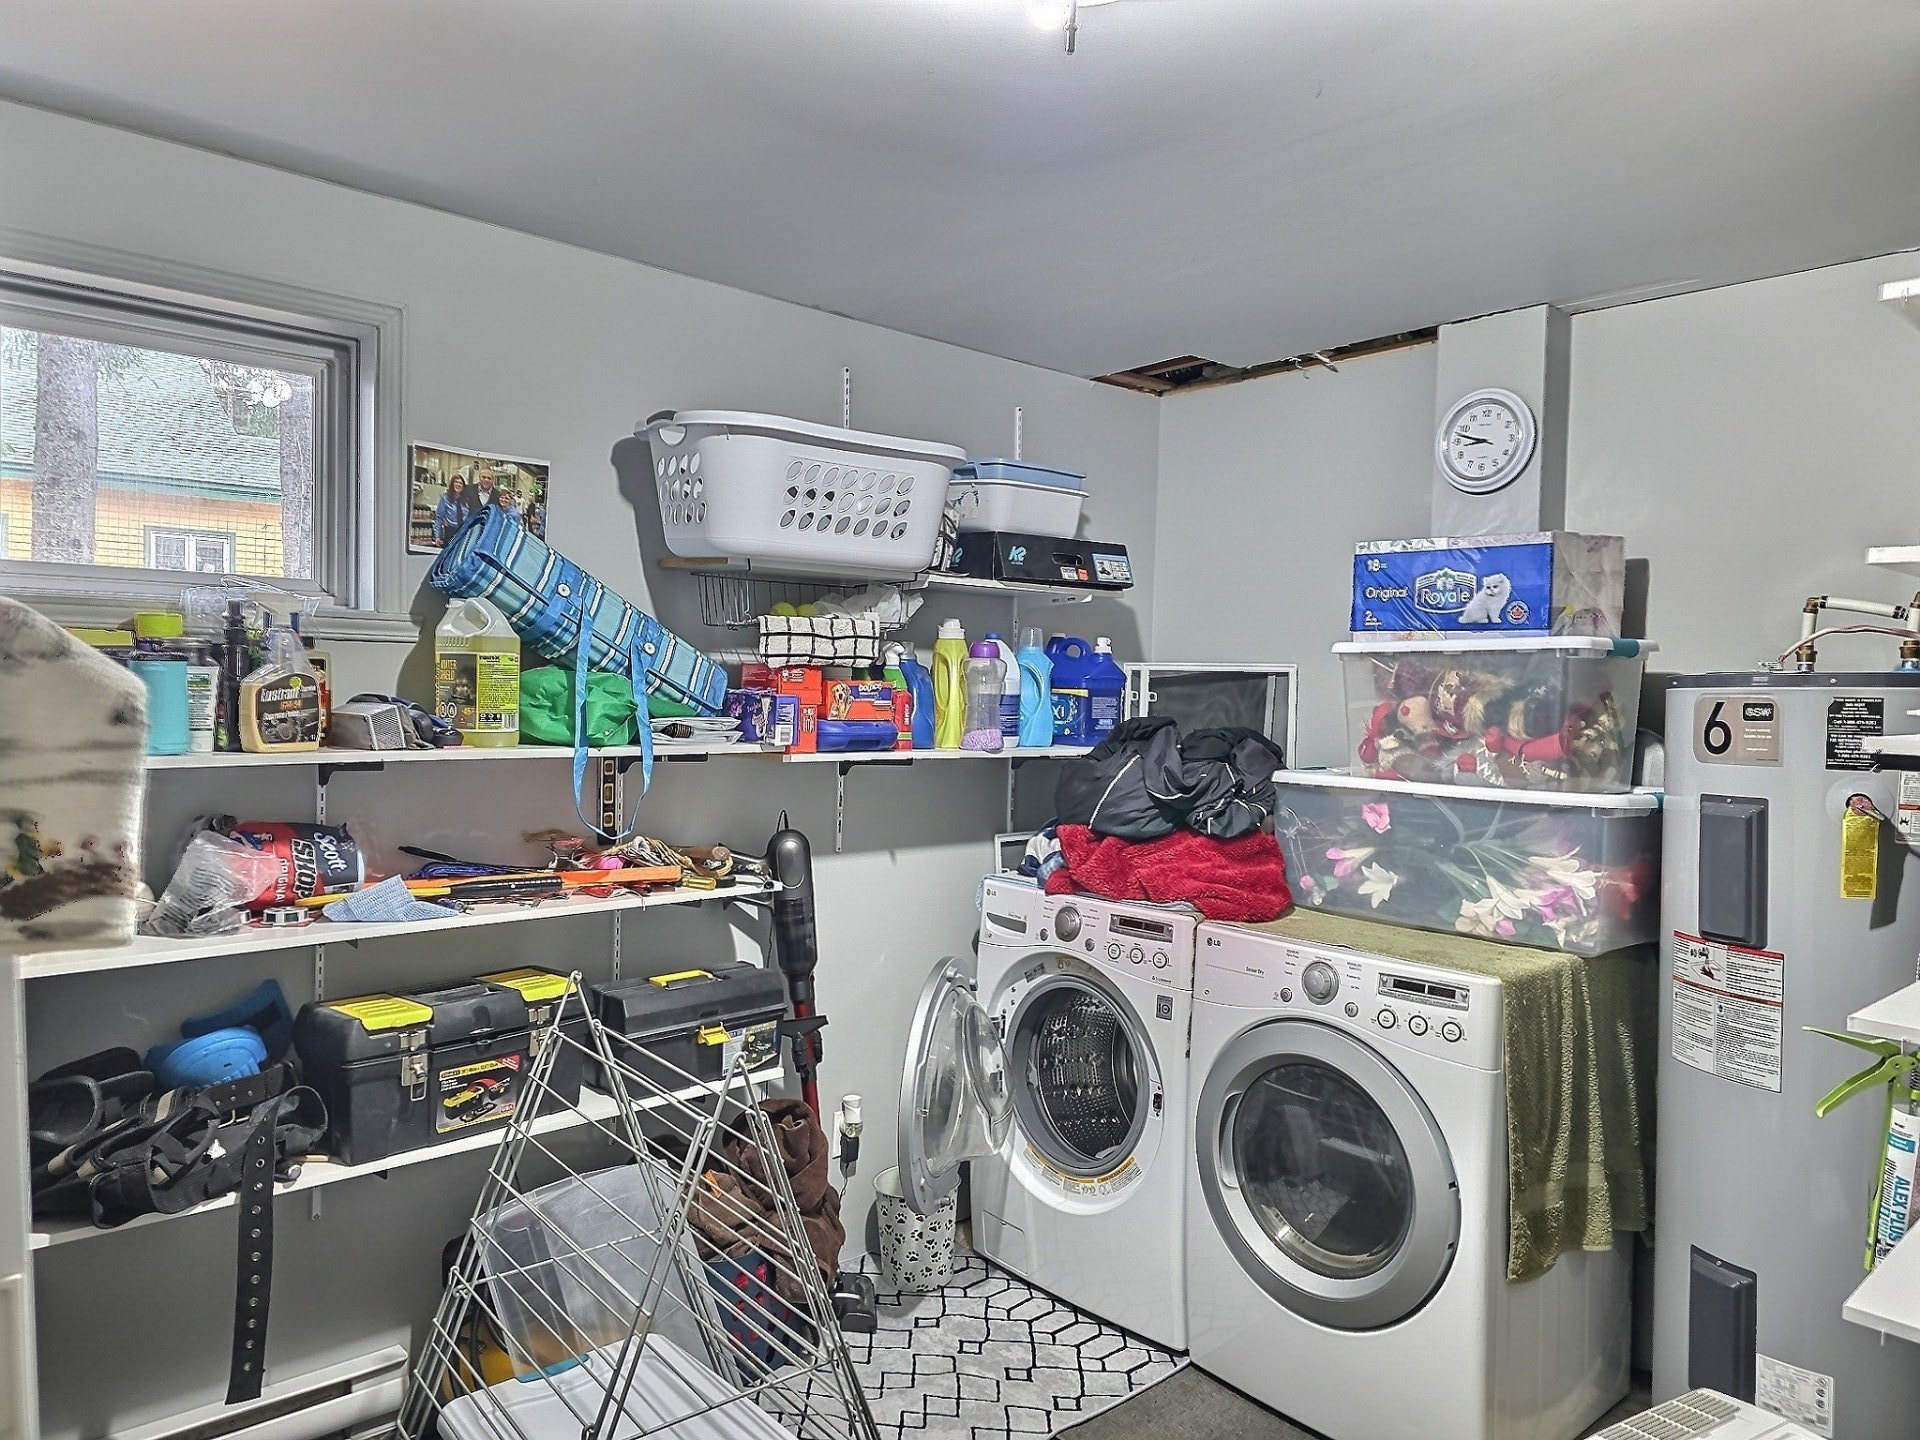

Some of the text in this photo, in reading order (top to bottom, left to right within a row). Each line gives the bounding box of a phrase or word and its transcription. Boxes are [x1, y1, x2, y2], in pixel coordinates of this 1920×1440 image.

[1008, 545, 1027, 562] K2
[1367, 558, 1381, 571] 18
[1365, 586, 1409, 602] Original
[1422, 588, 1471, 608] Royale
[1703, 701, 1733, 755] 6
[291, 838, 318, 899] SHOP
[313, 832, 349, 872] Scott
[1892, 1175, 1911, 1210] ALEX
[1888, 1209, 1907, 1243] PLUS
